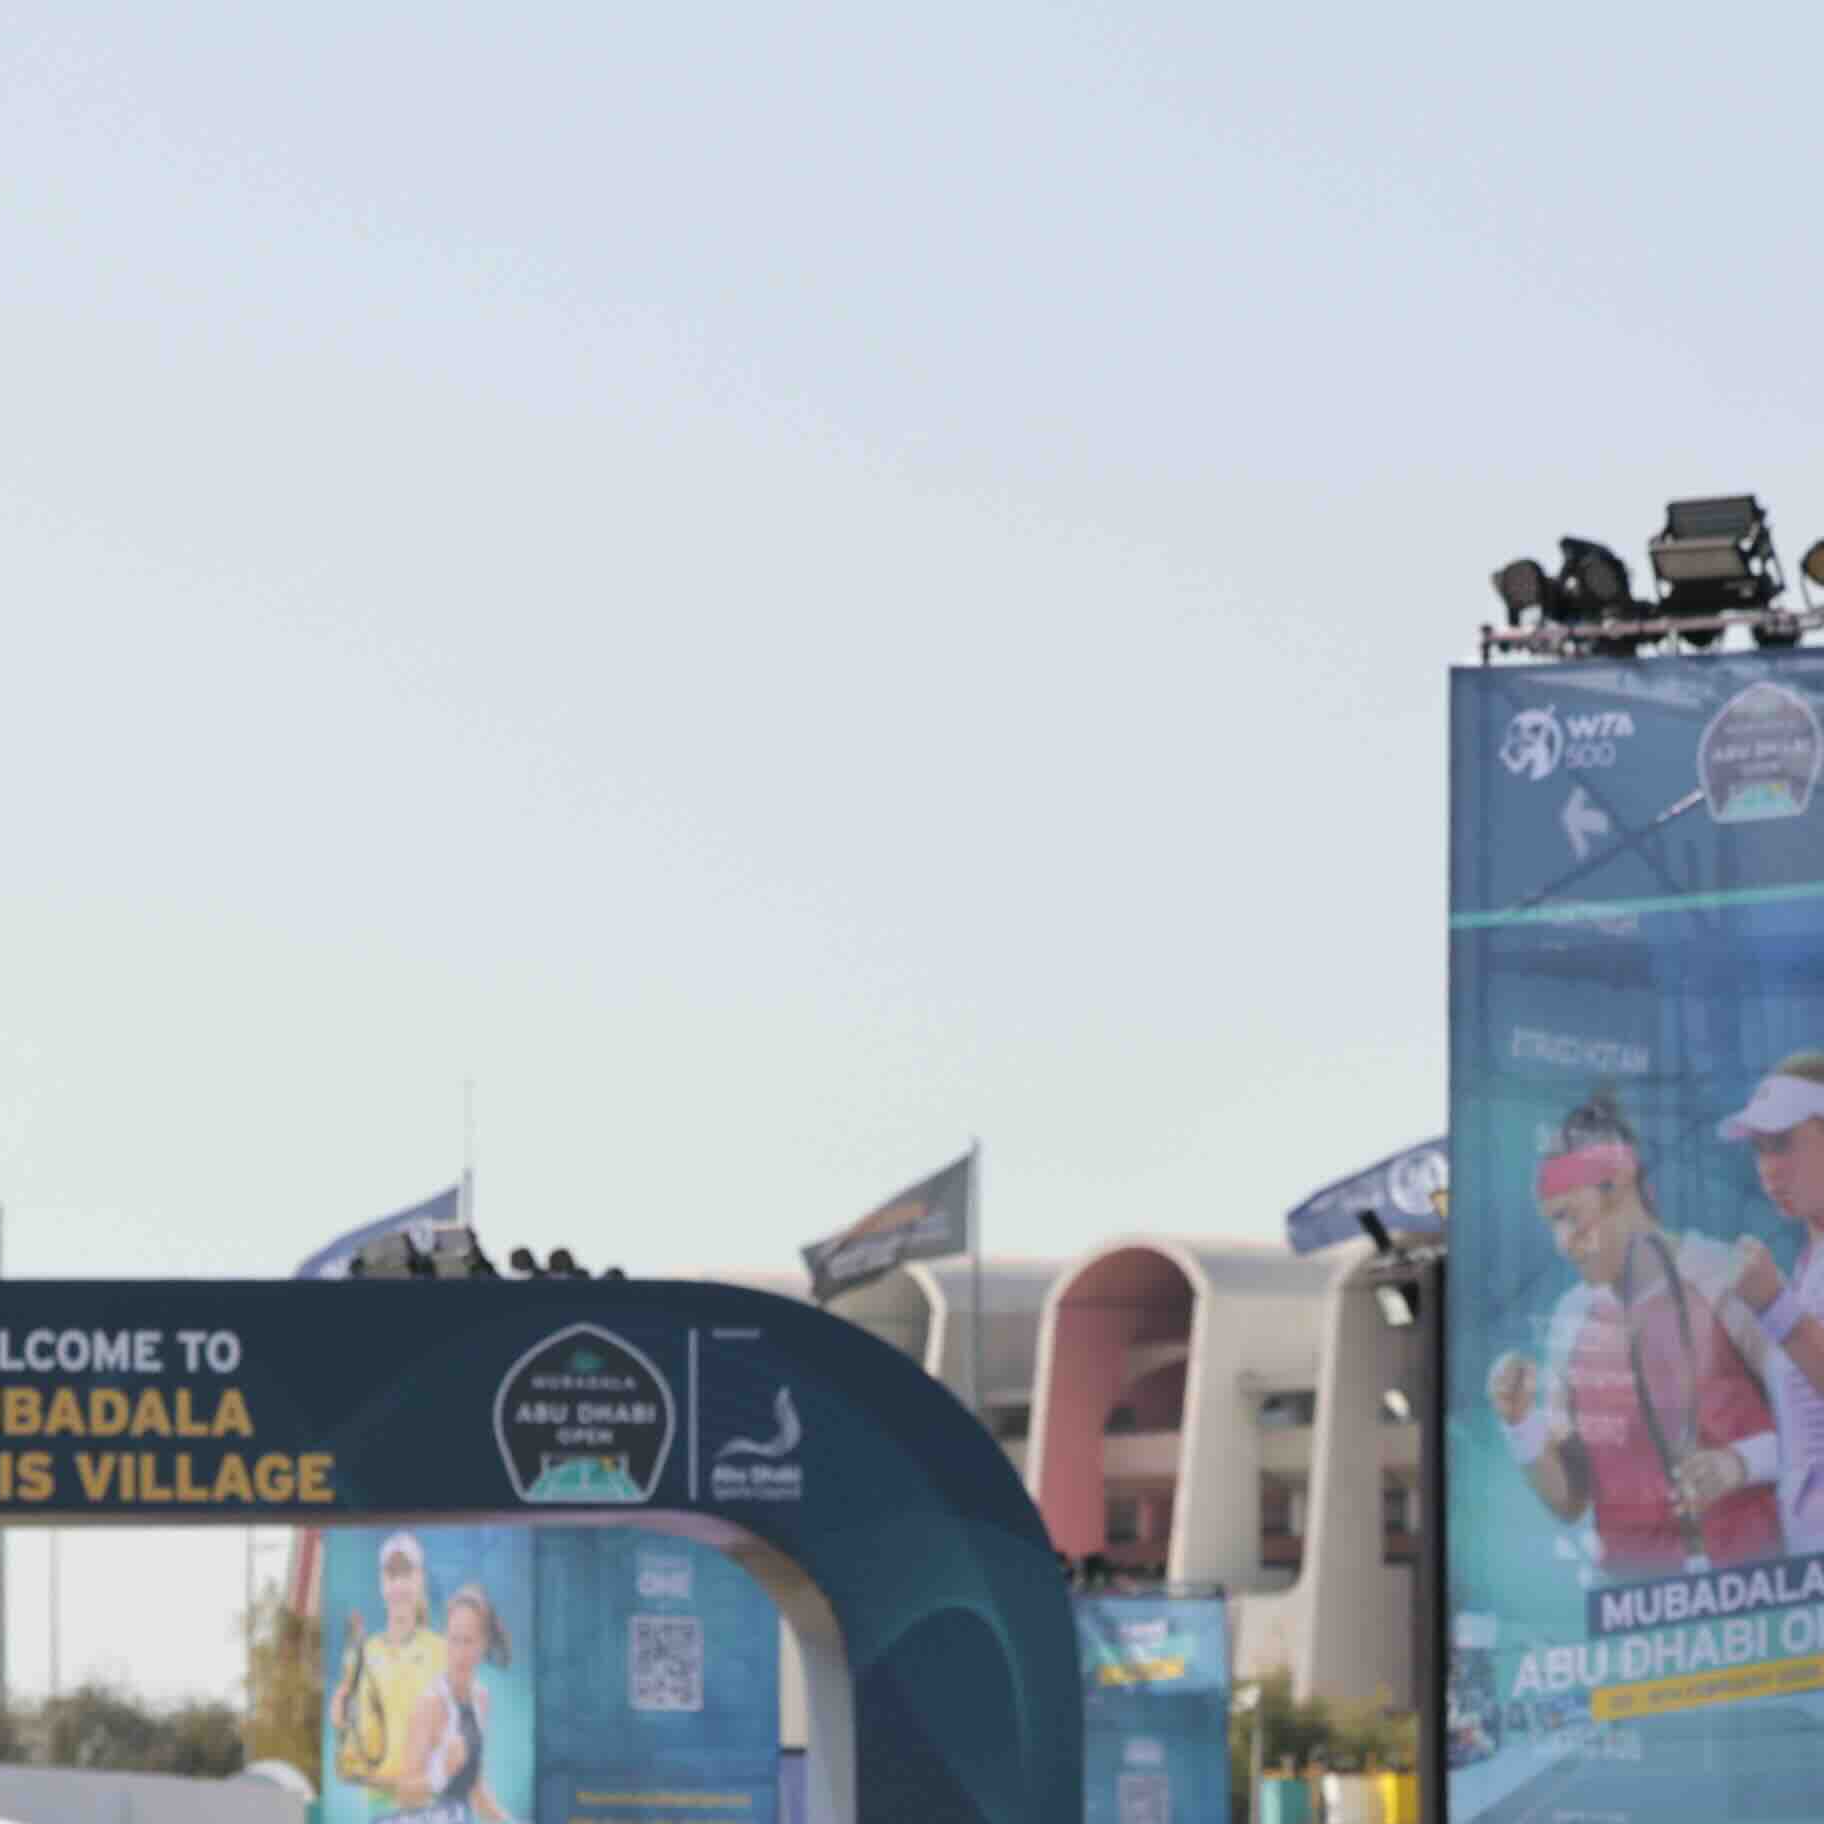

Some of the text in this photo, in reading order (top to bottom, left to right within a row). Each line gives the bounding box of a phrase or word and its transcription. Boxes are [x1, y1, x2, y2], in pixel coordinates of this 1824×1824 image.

[1566, 712, 1635, 737] WTA
[177, 1330, 242, 1374] TO
[515, 1403, 657, 1424] ABU DHABI
[554, 1427, 613, 1445] OPEN
[74, 1451, 336, 1503] VILLAGE
[1511, 1644, 1608, 1698] ABU
[1622, 1617, 1768, 1681] DHABI
